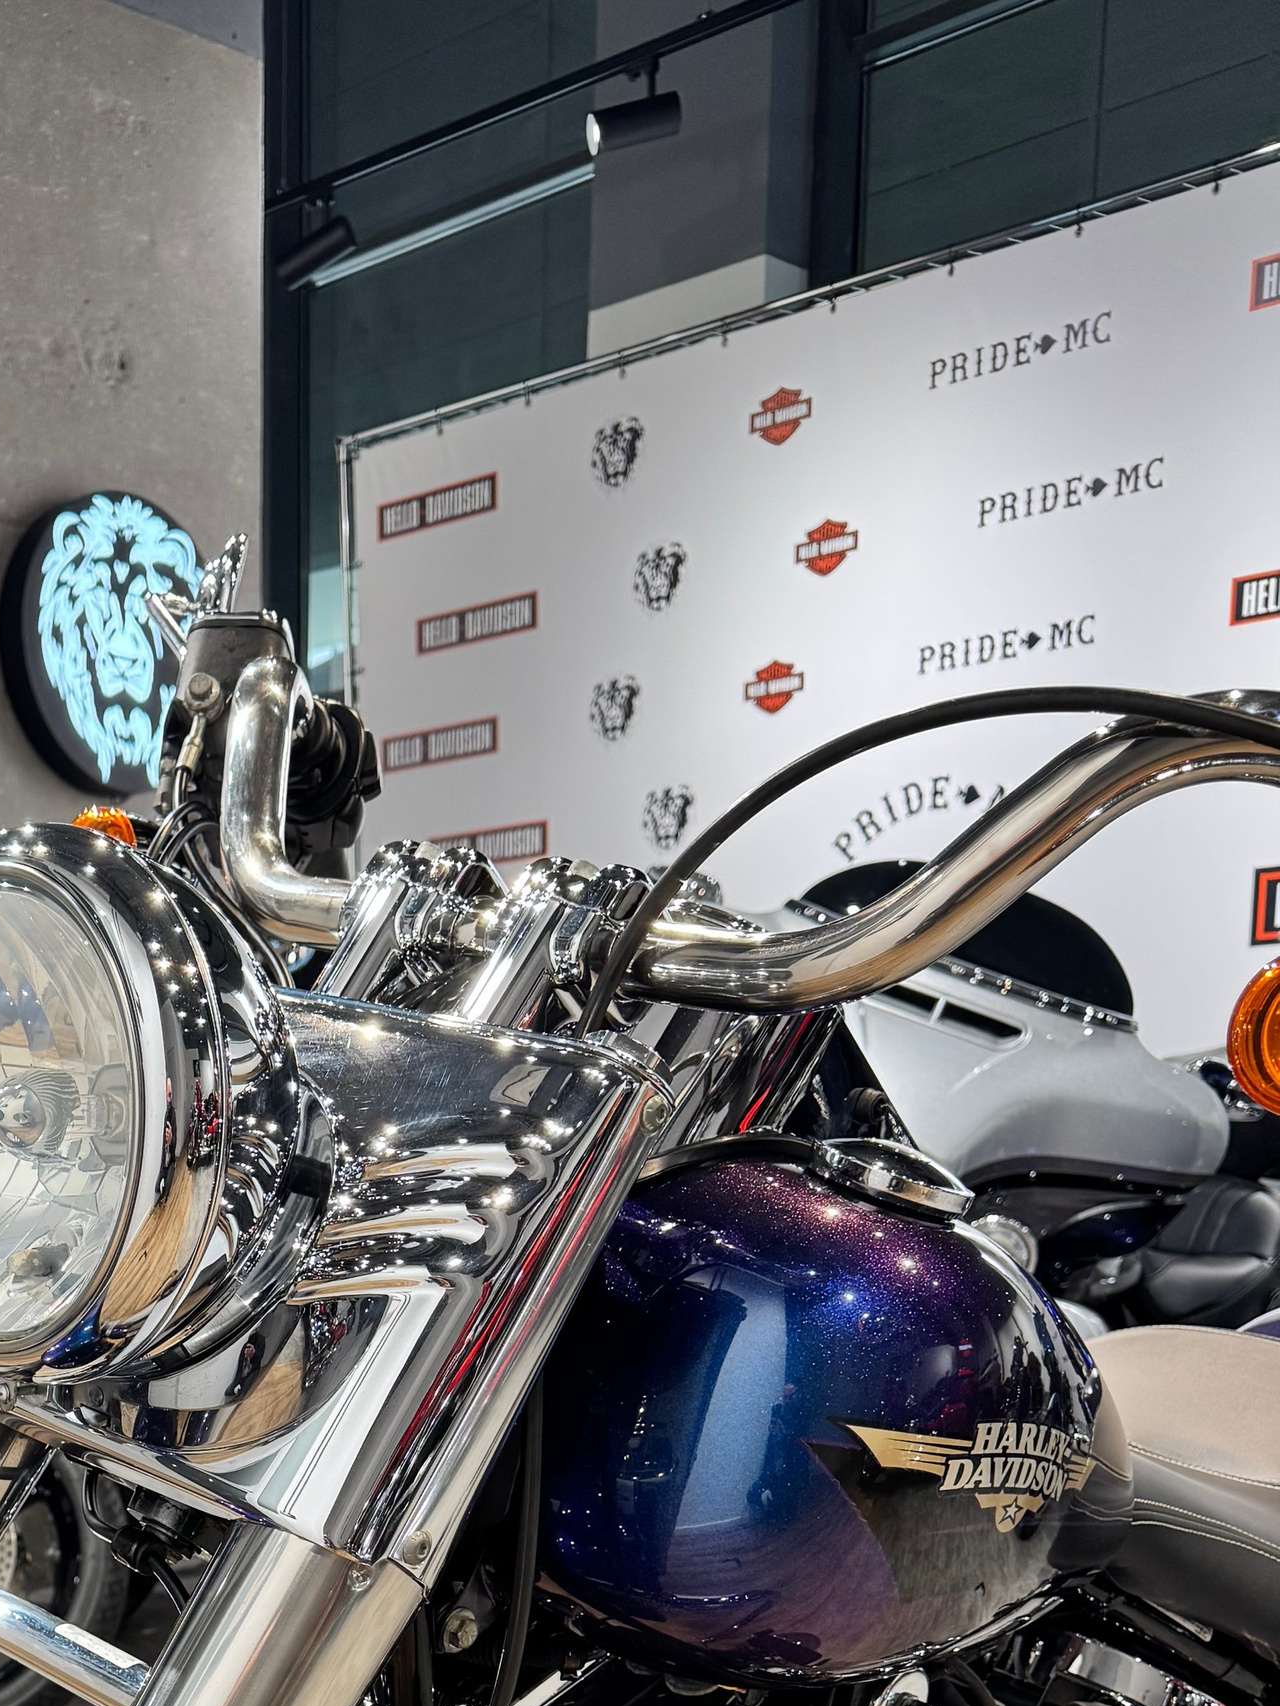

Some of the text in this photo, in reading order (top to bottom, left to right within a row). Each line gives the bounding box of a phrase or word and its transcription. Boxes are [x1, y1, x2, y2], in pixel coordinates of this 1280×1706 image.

[929, 311, 1113, 391] PRIDE MC
[977, 456, 1164, 529] PRIDE MC
[916, 614, 1096, 676] PRIDE MC
[831, 773, 953, 864] PRIDE
[938, 1456, 1069, 1503] DAVIDSON
